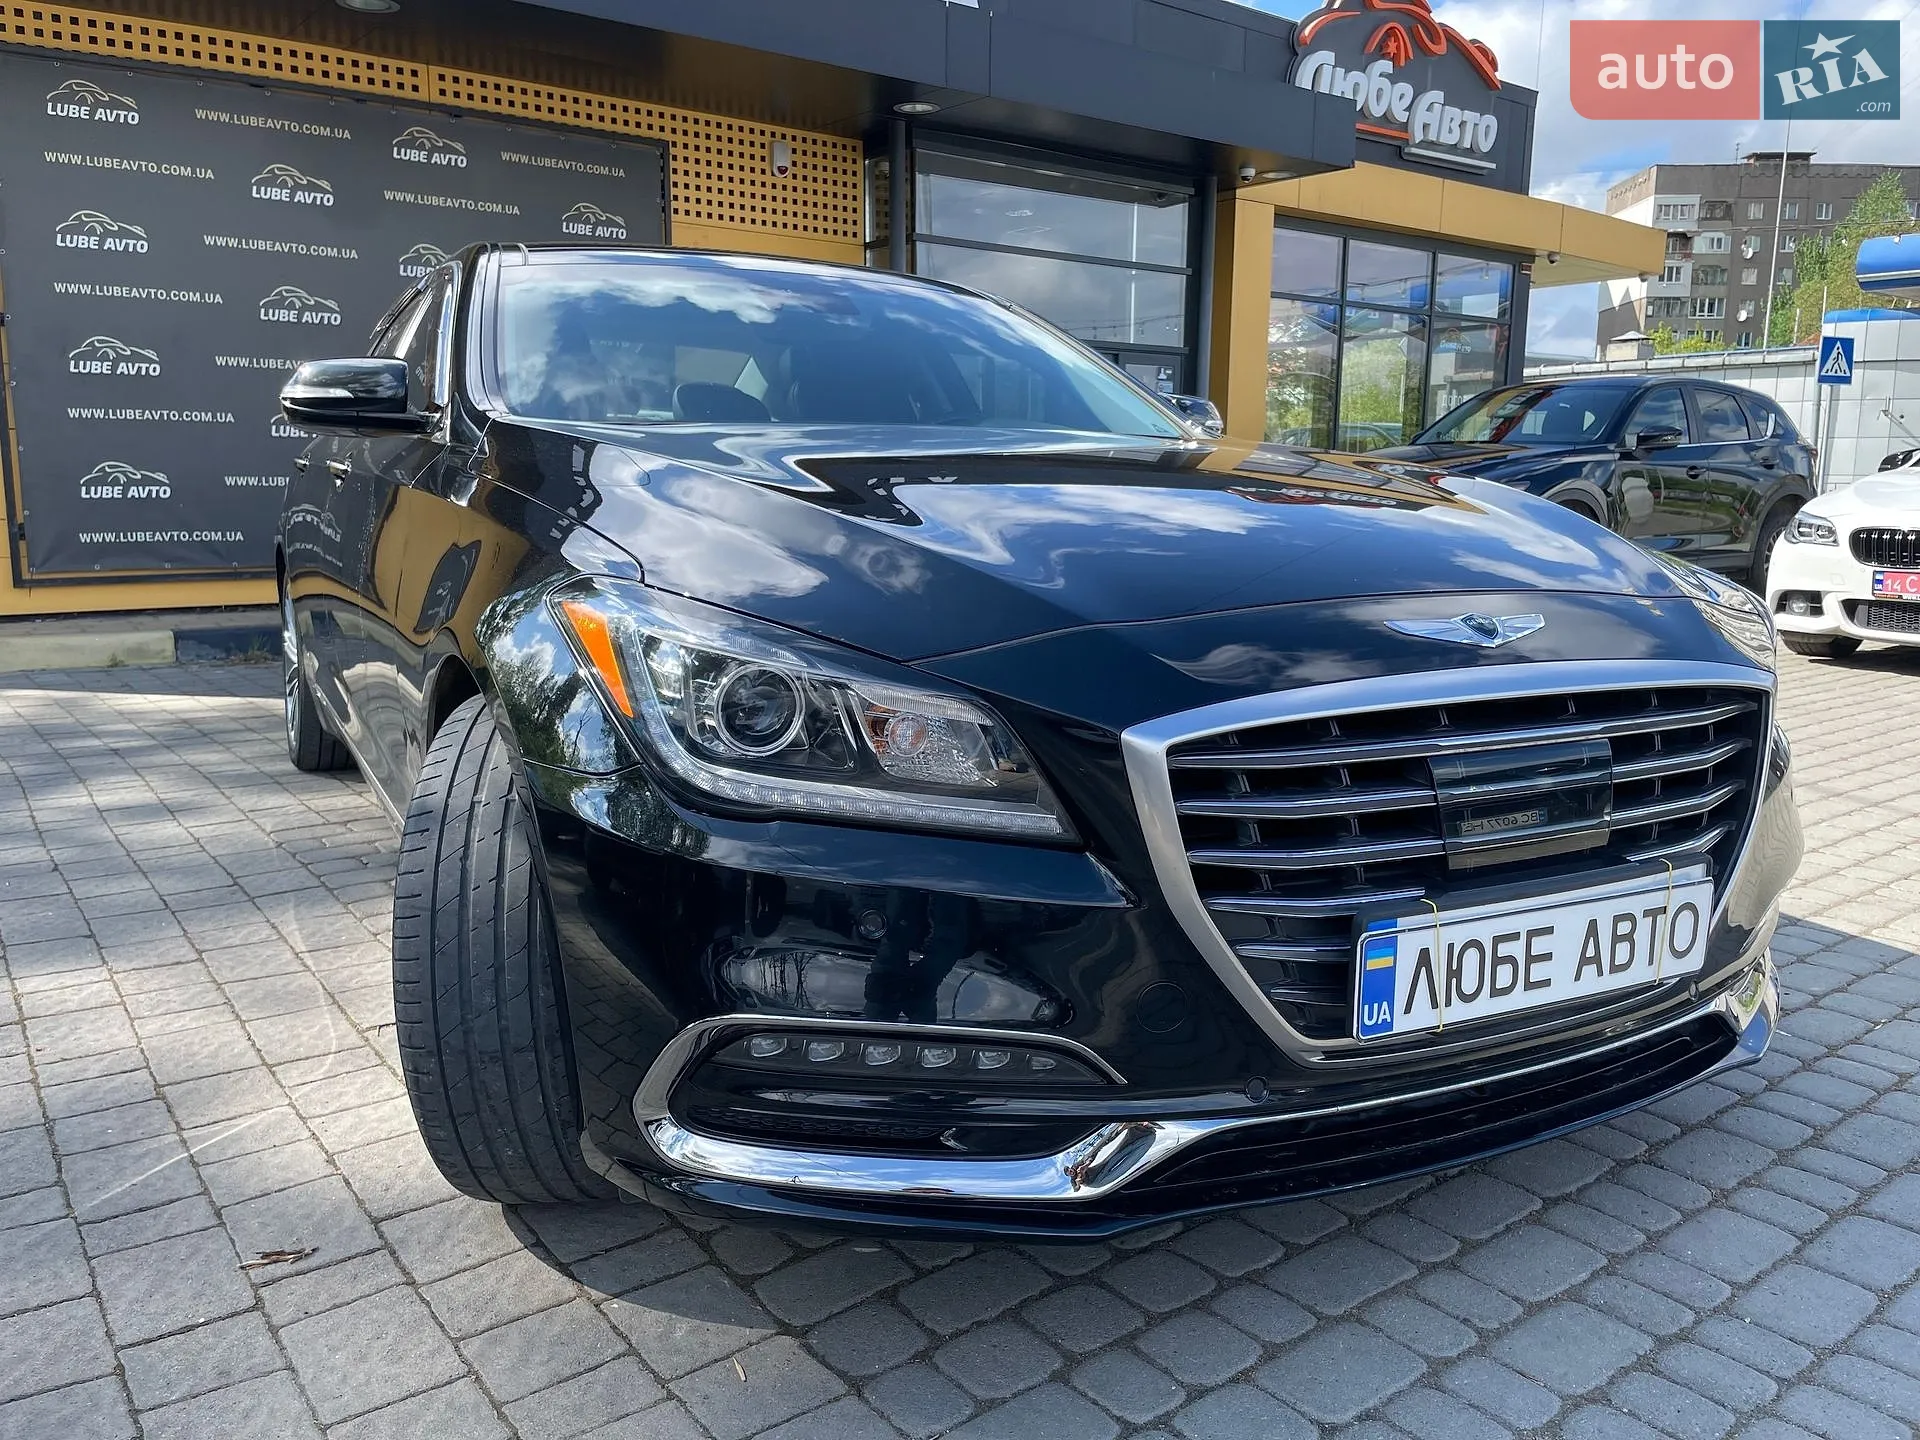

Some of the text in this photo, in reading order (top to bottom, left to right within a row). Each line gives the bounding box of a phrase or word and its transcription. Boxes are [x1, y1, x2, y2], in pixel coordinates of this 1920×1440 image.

[47, 102, 139, 125] LUBE AVTO
[194, 108, 352, 140] WWW.LUBEAVTO.COM.UA
[44, 151, 215, 180] WWW.LUBEAVTO.COM.UA
[393, 147, 467, 168] LUBE AVTO
[500, 151, 626, 178] WWW.LUBEAVTO.COM.UA
[252, 185, 334, 207] LUBE AVTO
[383, 190, 520, 216] WWW.LUBEAVTO.COM.UA
[563, 222, 627, 241] LUBE AVTO
[56, 234, 149, 253] LUBE AVTO
[203, 235, 358, 260] WWW.LUBEAVTO.COM.UA
[54, 282, 223, 305] WWW.LUBEAVTO.COM.UA
[260, 308, 341, 326] LUBE AVTO
[70, 360, 161, 377] LUBE AVTO
[68, 407, 235, 423] WWW.LUBEAVTO.COM.UA
[81, 485, 171, 499] LUBE AVTO
[79, 531, 244, 543] WWW.LUBEAVTO.COM.UA
[1886, 578, 1901, 592] 14
[1403, 902, 1700, 1015] ЛЮБЕ АВТО
[1363, 1001, 1392, 1026] UA
